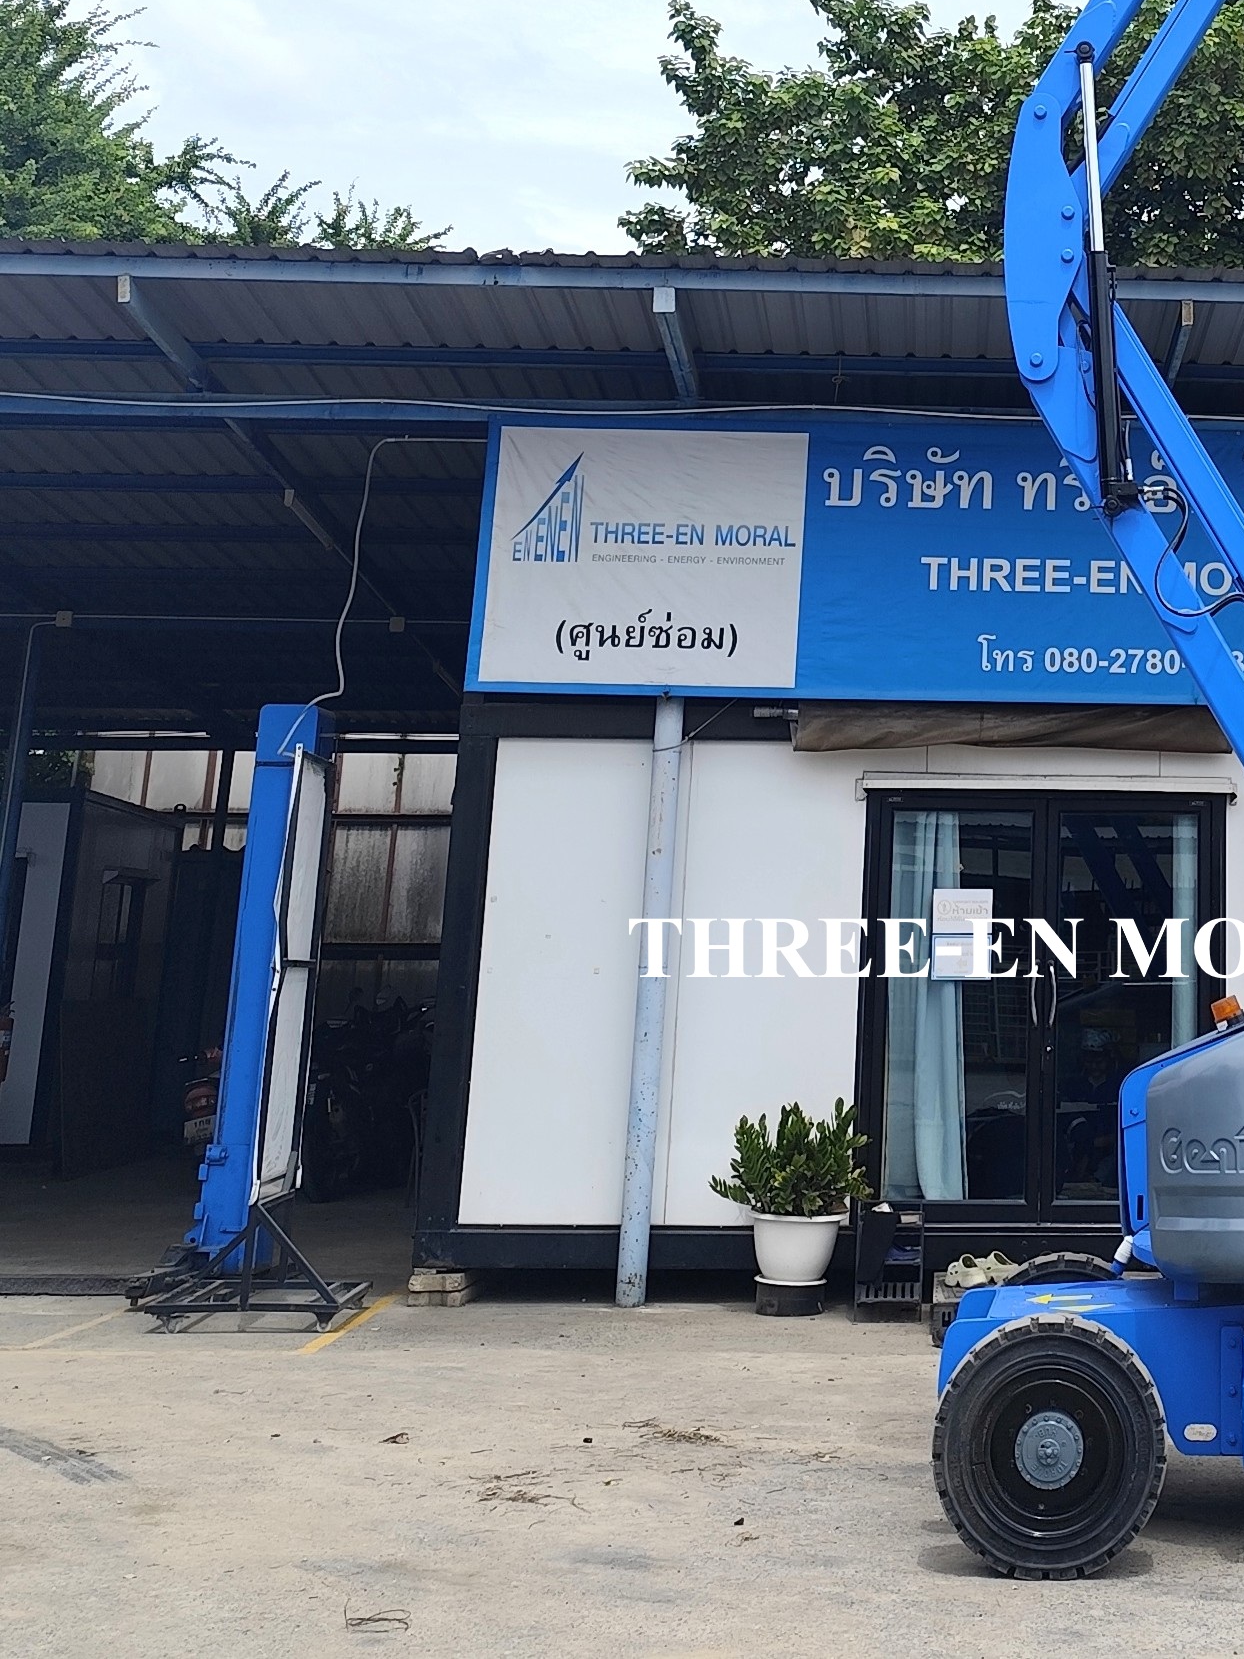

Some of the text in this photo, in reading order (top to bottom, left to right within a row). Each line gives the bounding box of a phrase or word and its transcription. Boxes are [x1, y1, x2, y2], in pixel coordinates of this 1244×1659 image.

[823, 445, 992, 510] บริษัท
[590, 521, 796, 547] THREE-EN MORAL
[591, 553, 657, 563] ENGINEERING
[667, 555, 707, 564] ENERGY
[716, 556, 786, 566] ENVIRONMENT
[555, 608, 738, 661] (ศูนย์ซ่อม)
[977, 634, 1035, 672] โทร
